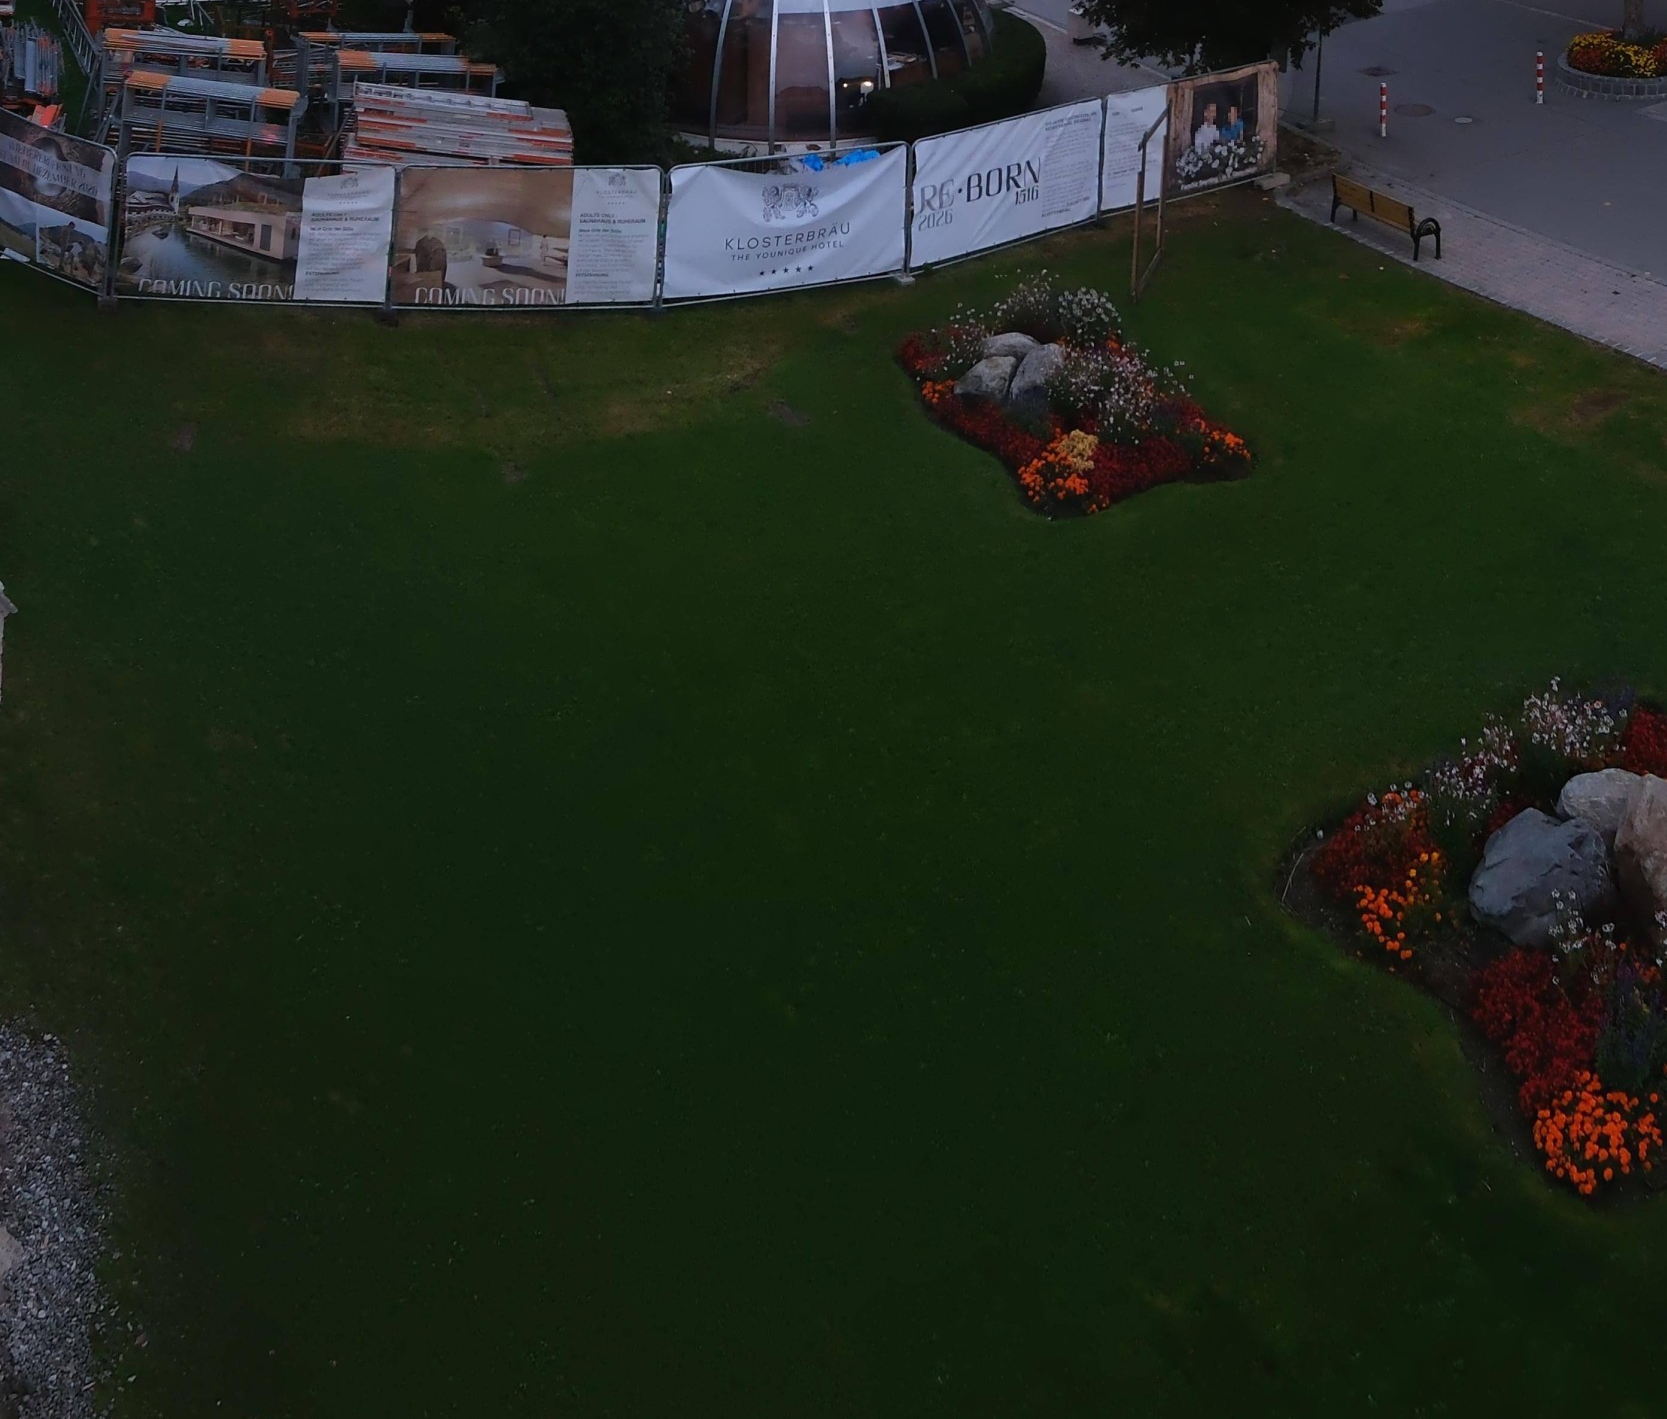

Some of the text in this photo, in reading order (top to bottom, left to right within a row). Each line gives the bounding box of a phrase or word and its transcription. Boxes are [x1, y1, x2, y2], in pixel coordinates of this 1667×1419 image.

[1015, 185, 1039, 205] 1516
[918, 210, 953, 231] 2026
[724, 222, 850, 251] KLOSTERBRÄU
[731, 239, 843, 261] THE YOUNIQUE HOTEL
[138, 278, 222, 300] COMING
[227, 281, 294, 301] SOON!
[414, 286, 496, 305] COMING
[502, 287, 565, 305] SOON!
